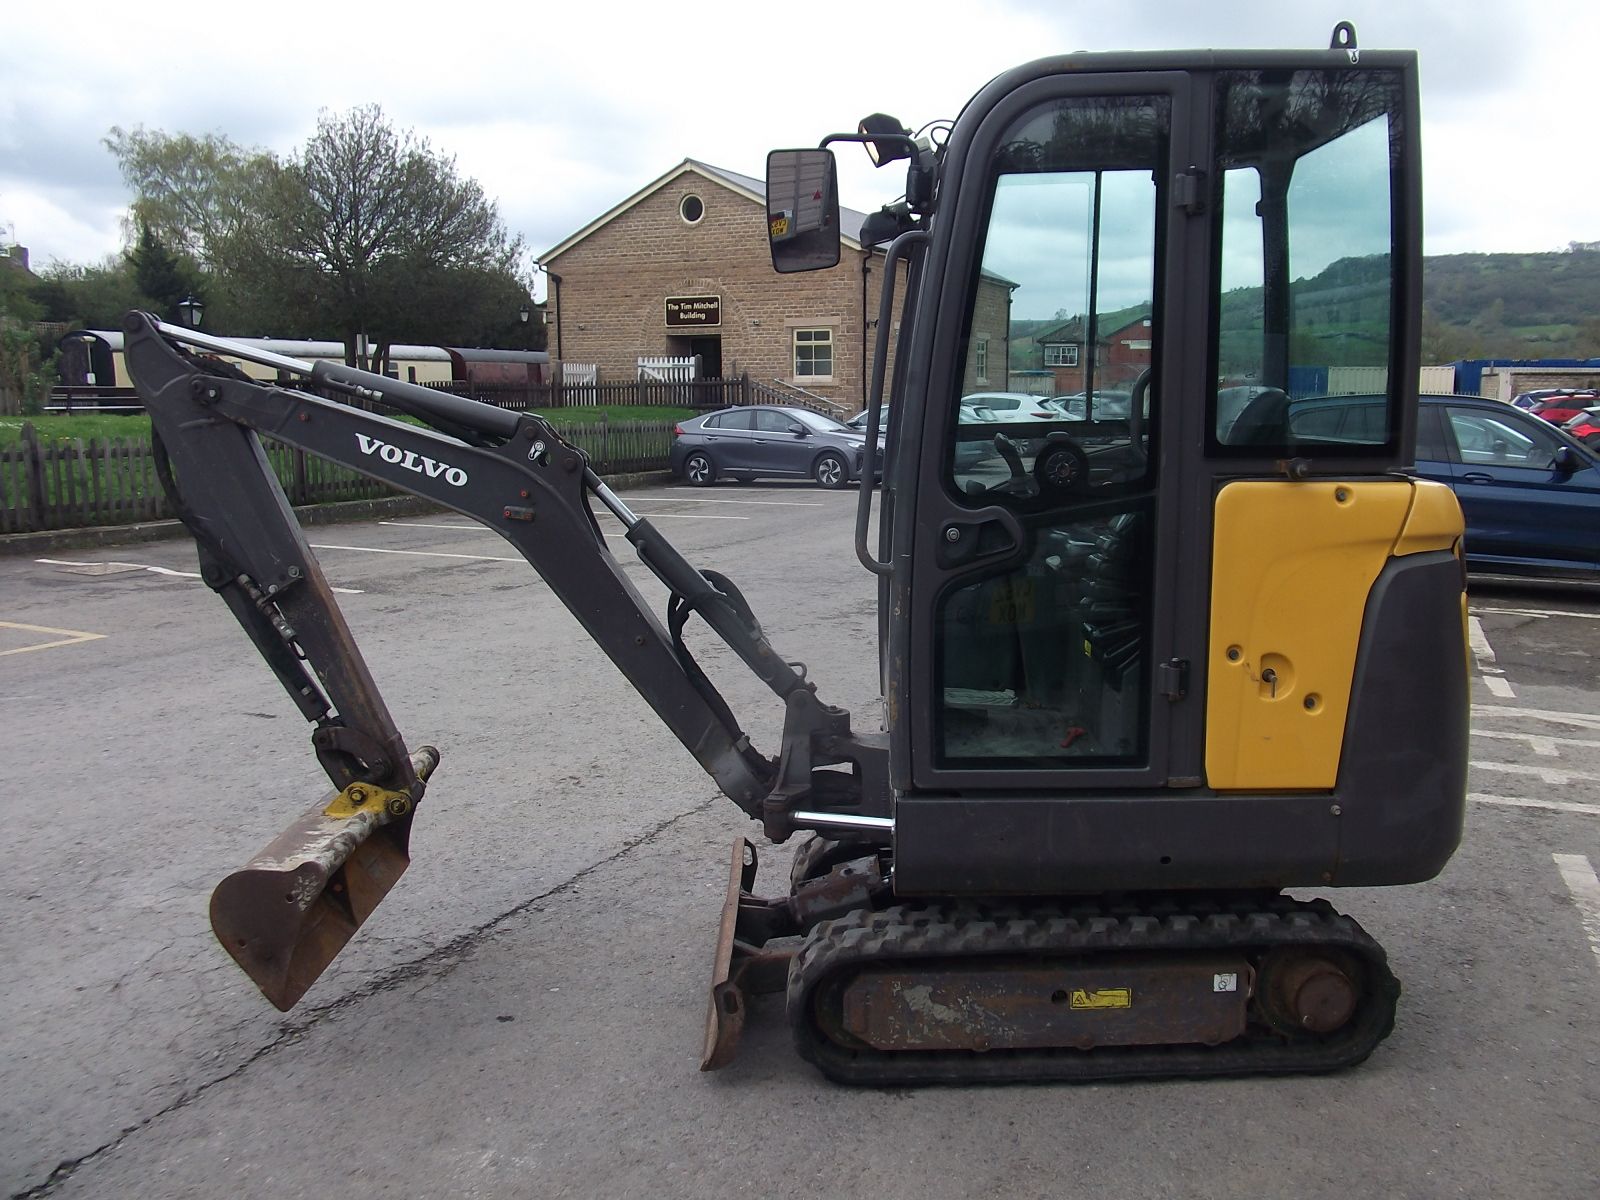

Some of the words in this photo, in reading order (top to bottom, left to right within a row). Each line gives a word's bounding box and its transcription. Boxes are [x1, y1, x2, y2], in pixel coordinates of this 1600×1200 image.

[680, 302, 692, 310] Tim
[693, 301, 718, 309] Mitchell
[679, 311, 706, 320] Building
[355, 432, 468, 487] VOLVO
